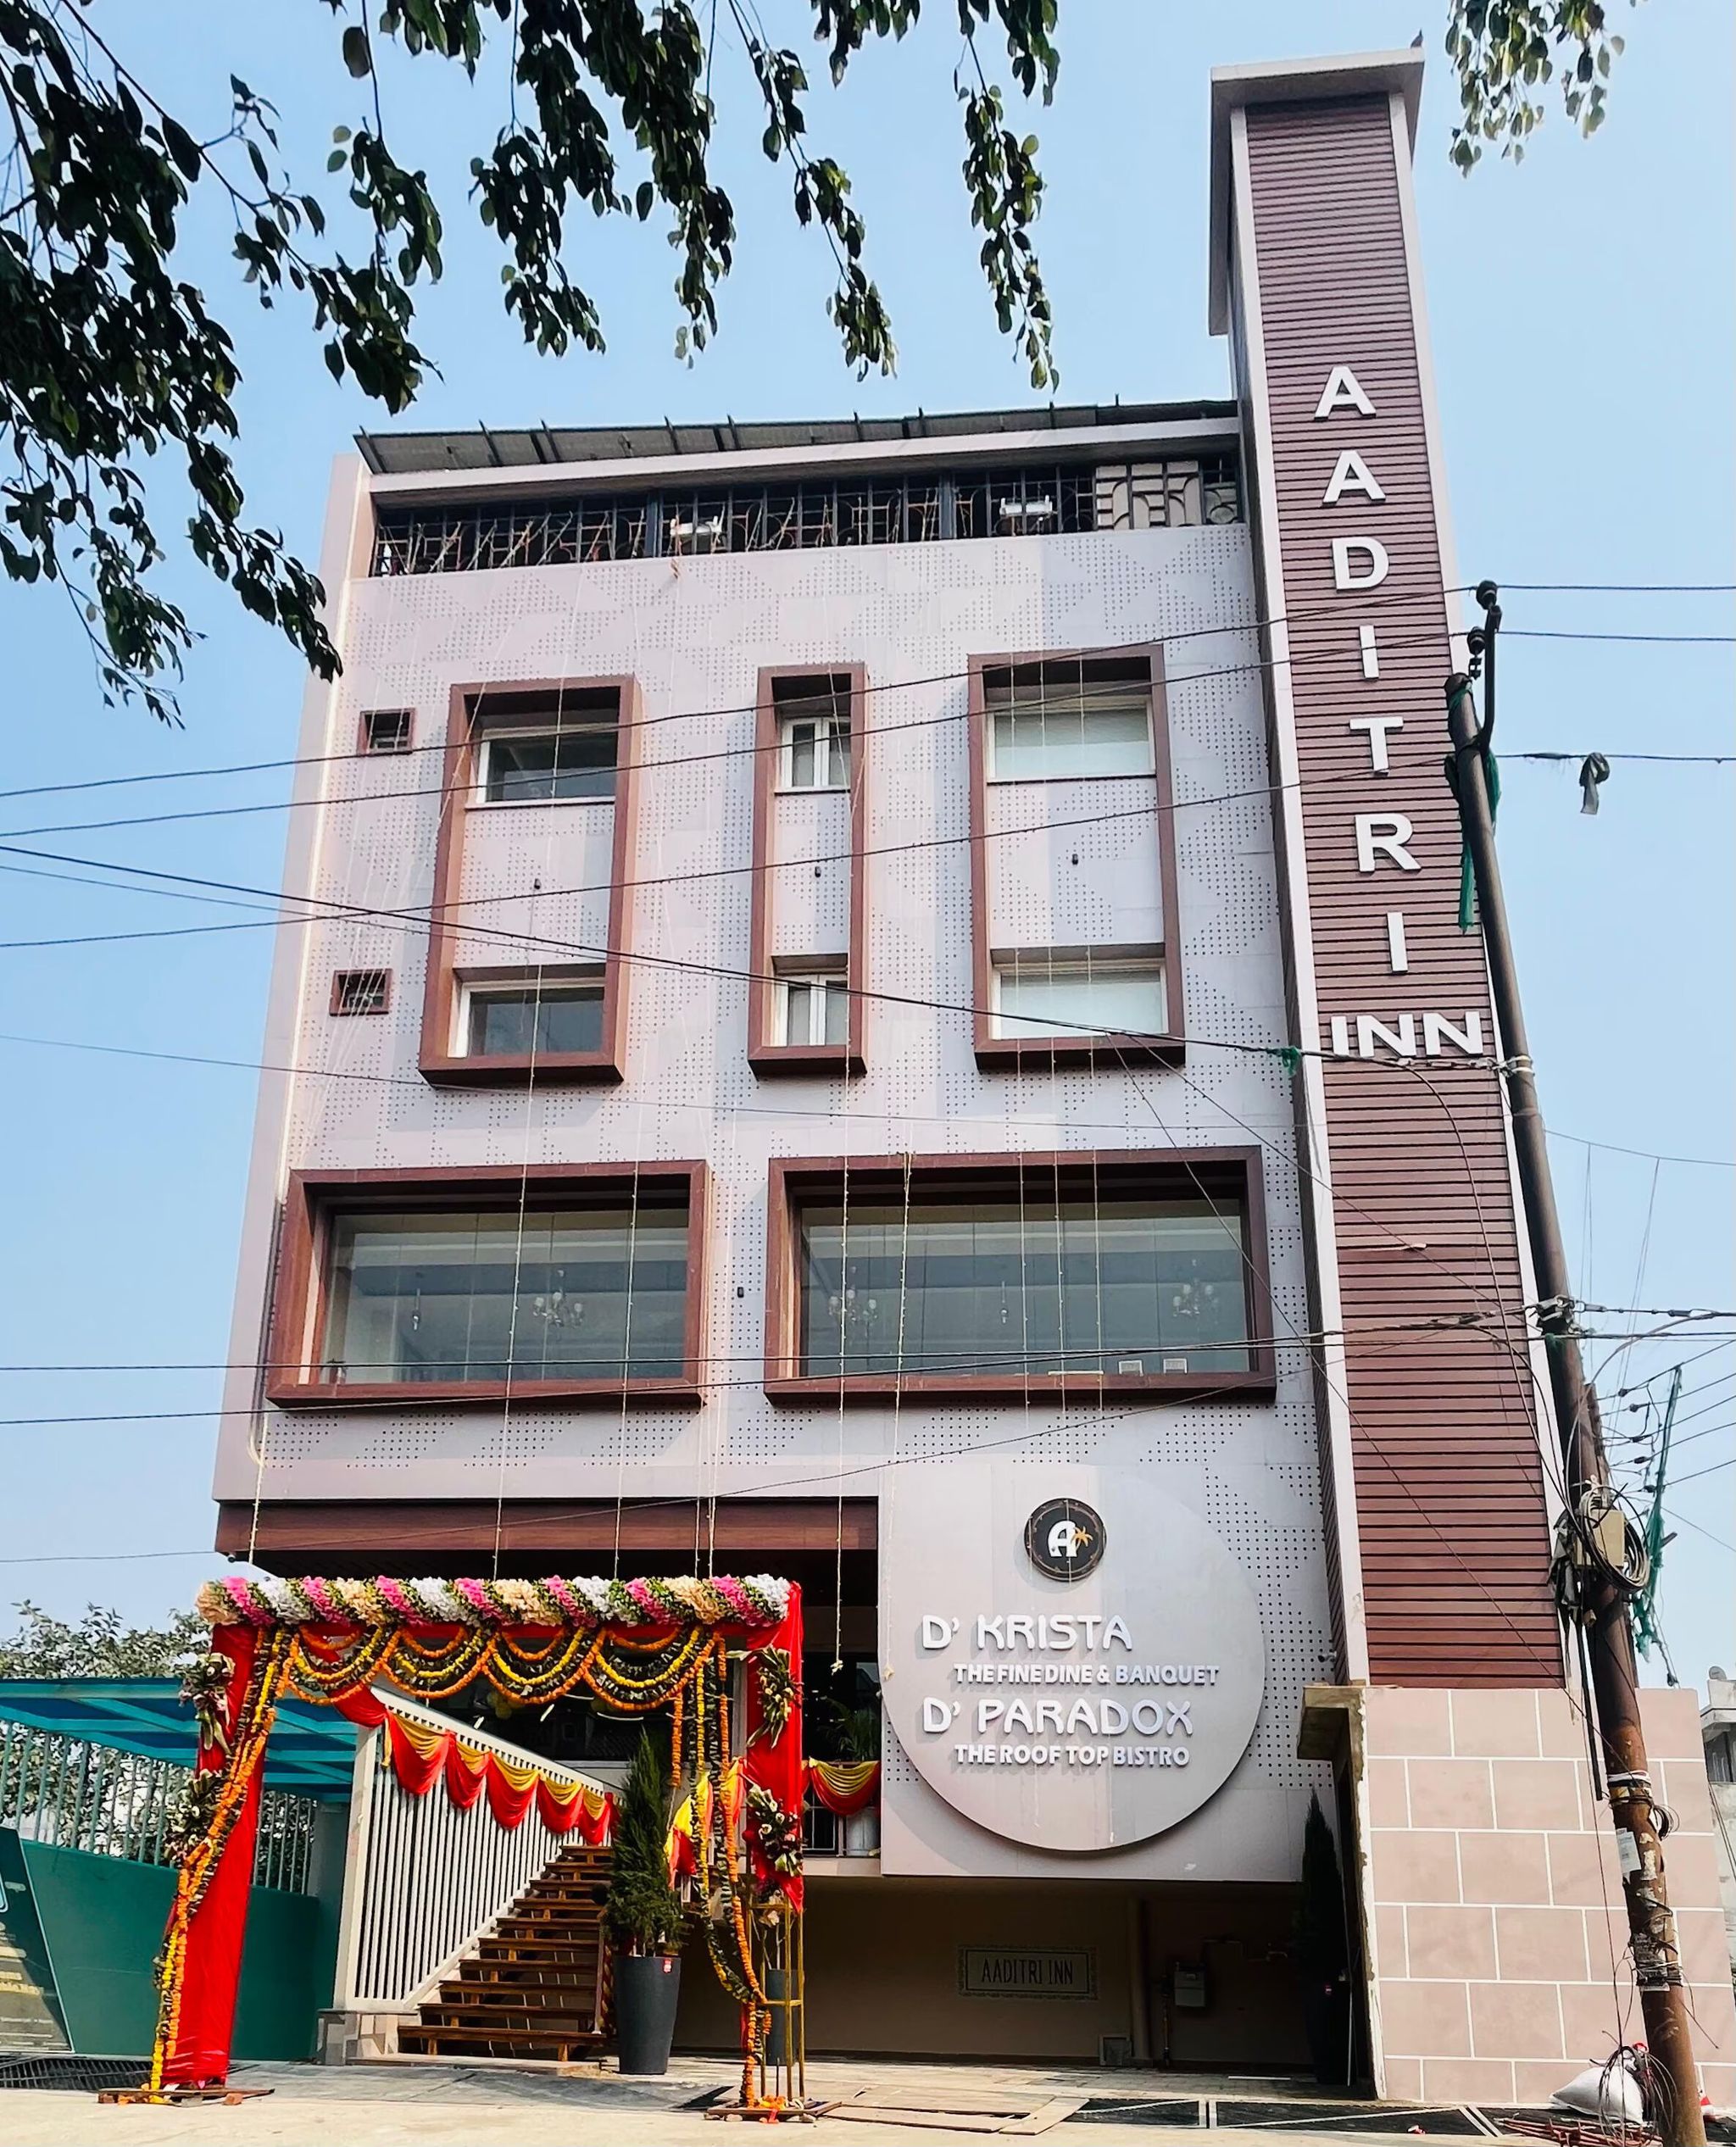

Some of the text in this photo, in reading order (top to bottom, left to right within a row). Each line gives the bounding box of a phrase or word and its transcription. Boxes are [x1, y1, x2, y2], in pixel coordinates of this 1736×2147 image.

[1314, 365, 1422, 973] AADITRI
[1330, 1010, 1484, 1059] INN
[922, 1614, 1132, 1651] D' KRISTA
[954, 1663, 1221, 1686] THE FINE DINE & BANQUET
[922, 1696, 1194, 1736] D' PARADOX
[954, 1744, 1190, 1766] THE ROOF TOP BISTRO
[982, 1958, 1073, 1985] AADITRI INN
